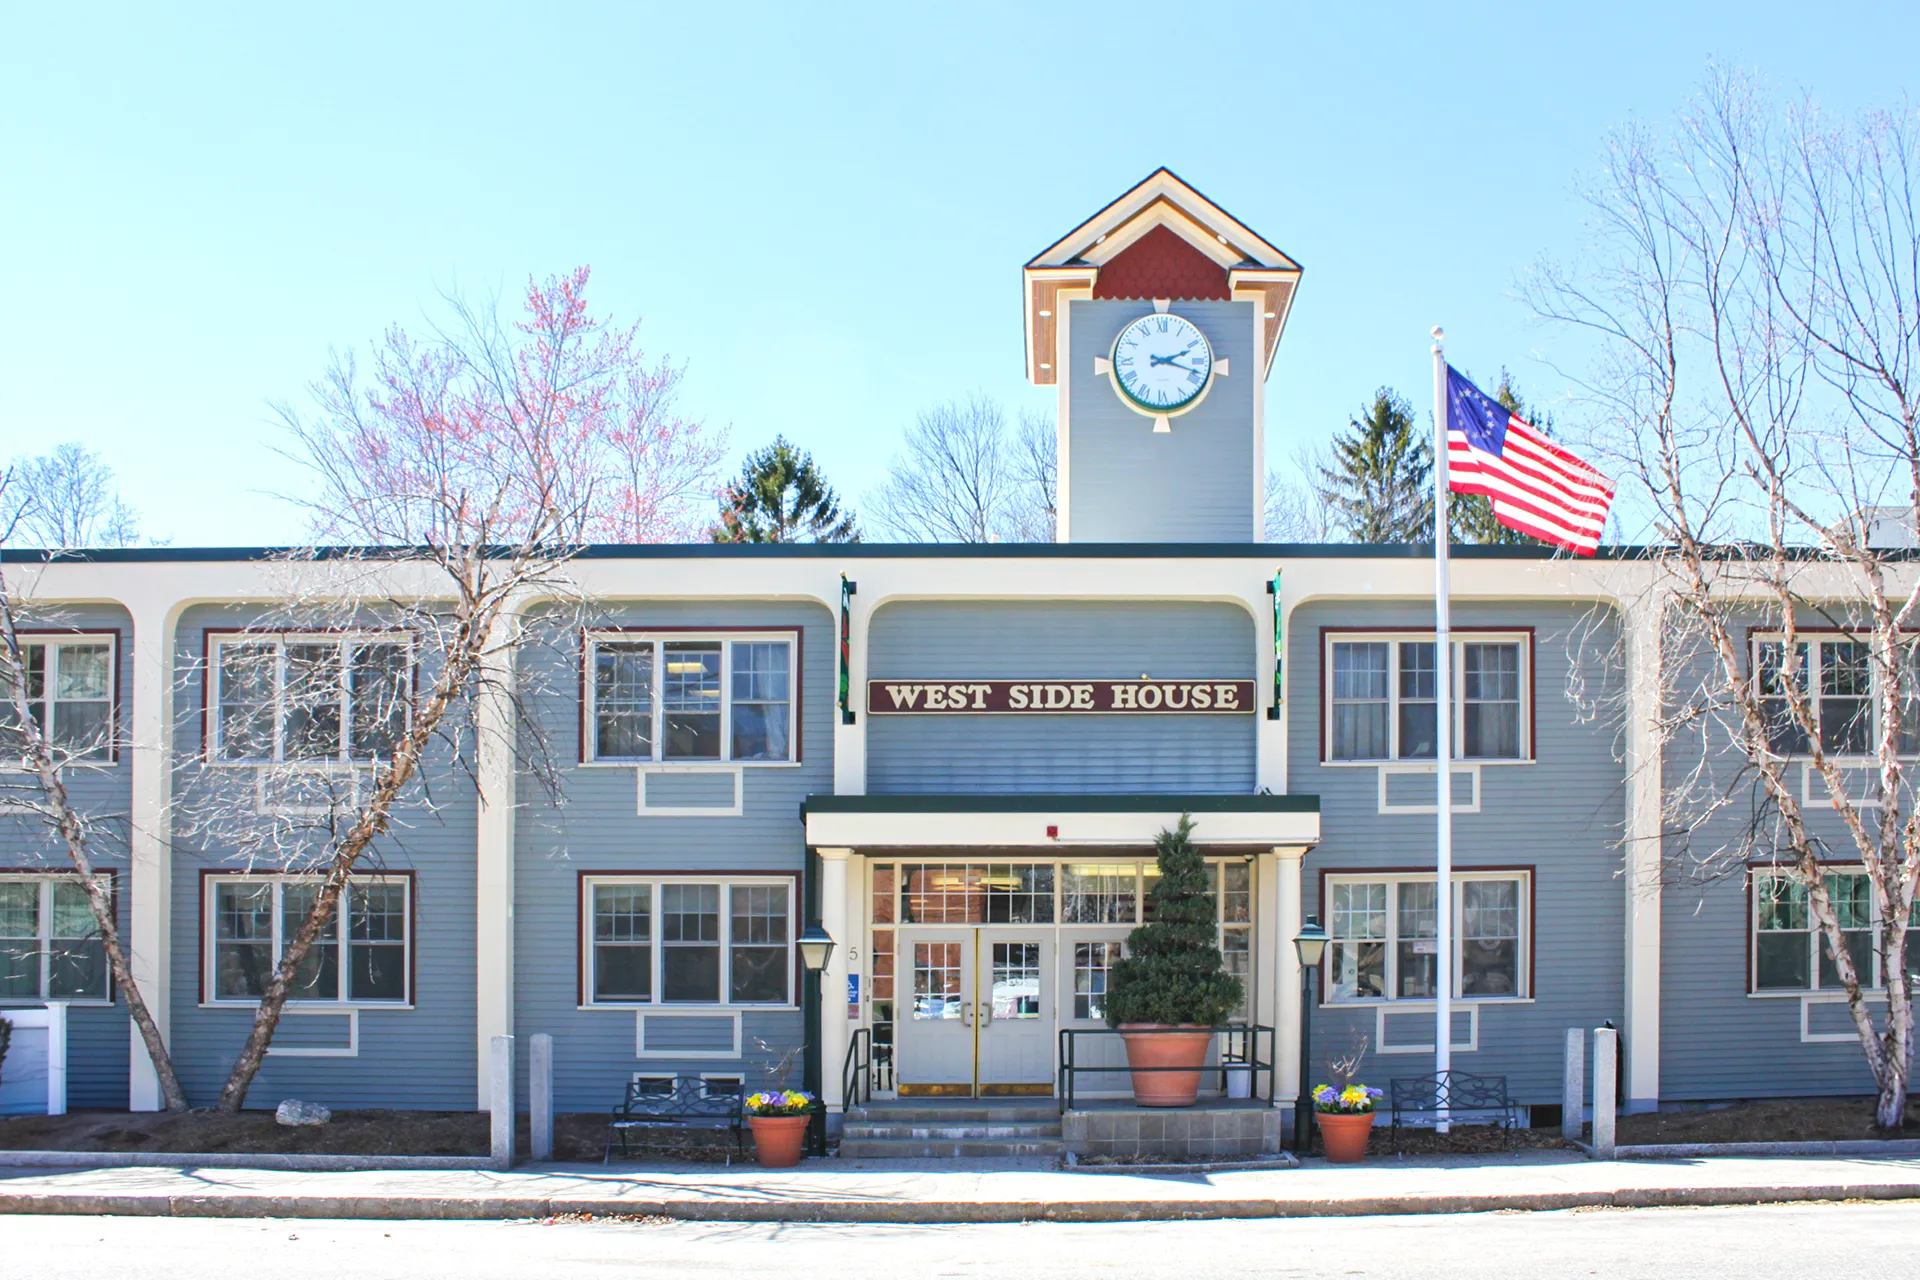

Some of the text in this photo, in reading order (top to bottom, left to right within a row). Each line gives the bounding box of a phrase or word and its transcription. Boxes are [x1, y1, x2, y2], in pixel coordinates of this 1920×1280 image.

[1138, 324, 1150, 338] XI
[1156, 321, 1168, 333] XII
[1175, 325, 1184, 337] I
[1126, 339, 1138, 349] X
[1186, 339, 1199, 349] II
[1121, 356, 1133, 366] IX
[1157, 390, 1168, 402] VI
[1177, 387, 1186, 398] V
[885, 684, 1239, 709] WEST SIDE HOUSE
[849, 946, 858, 961] 5
